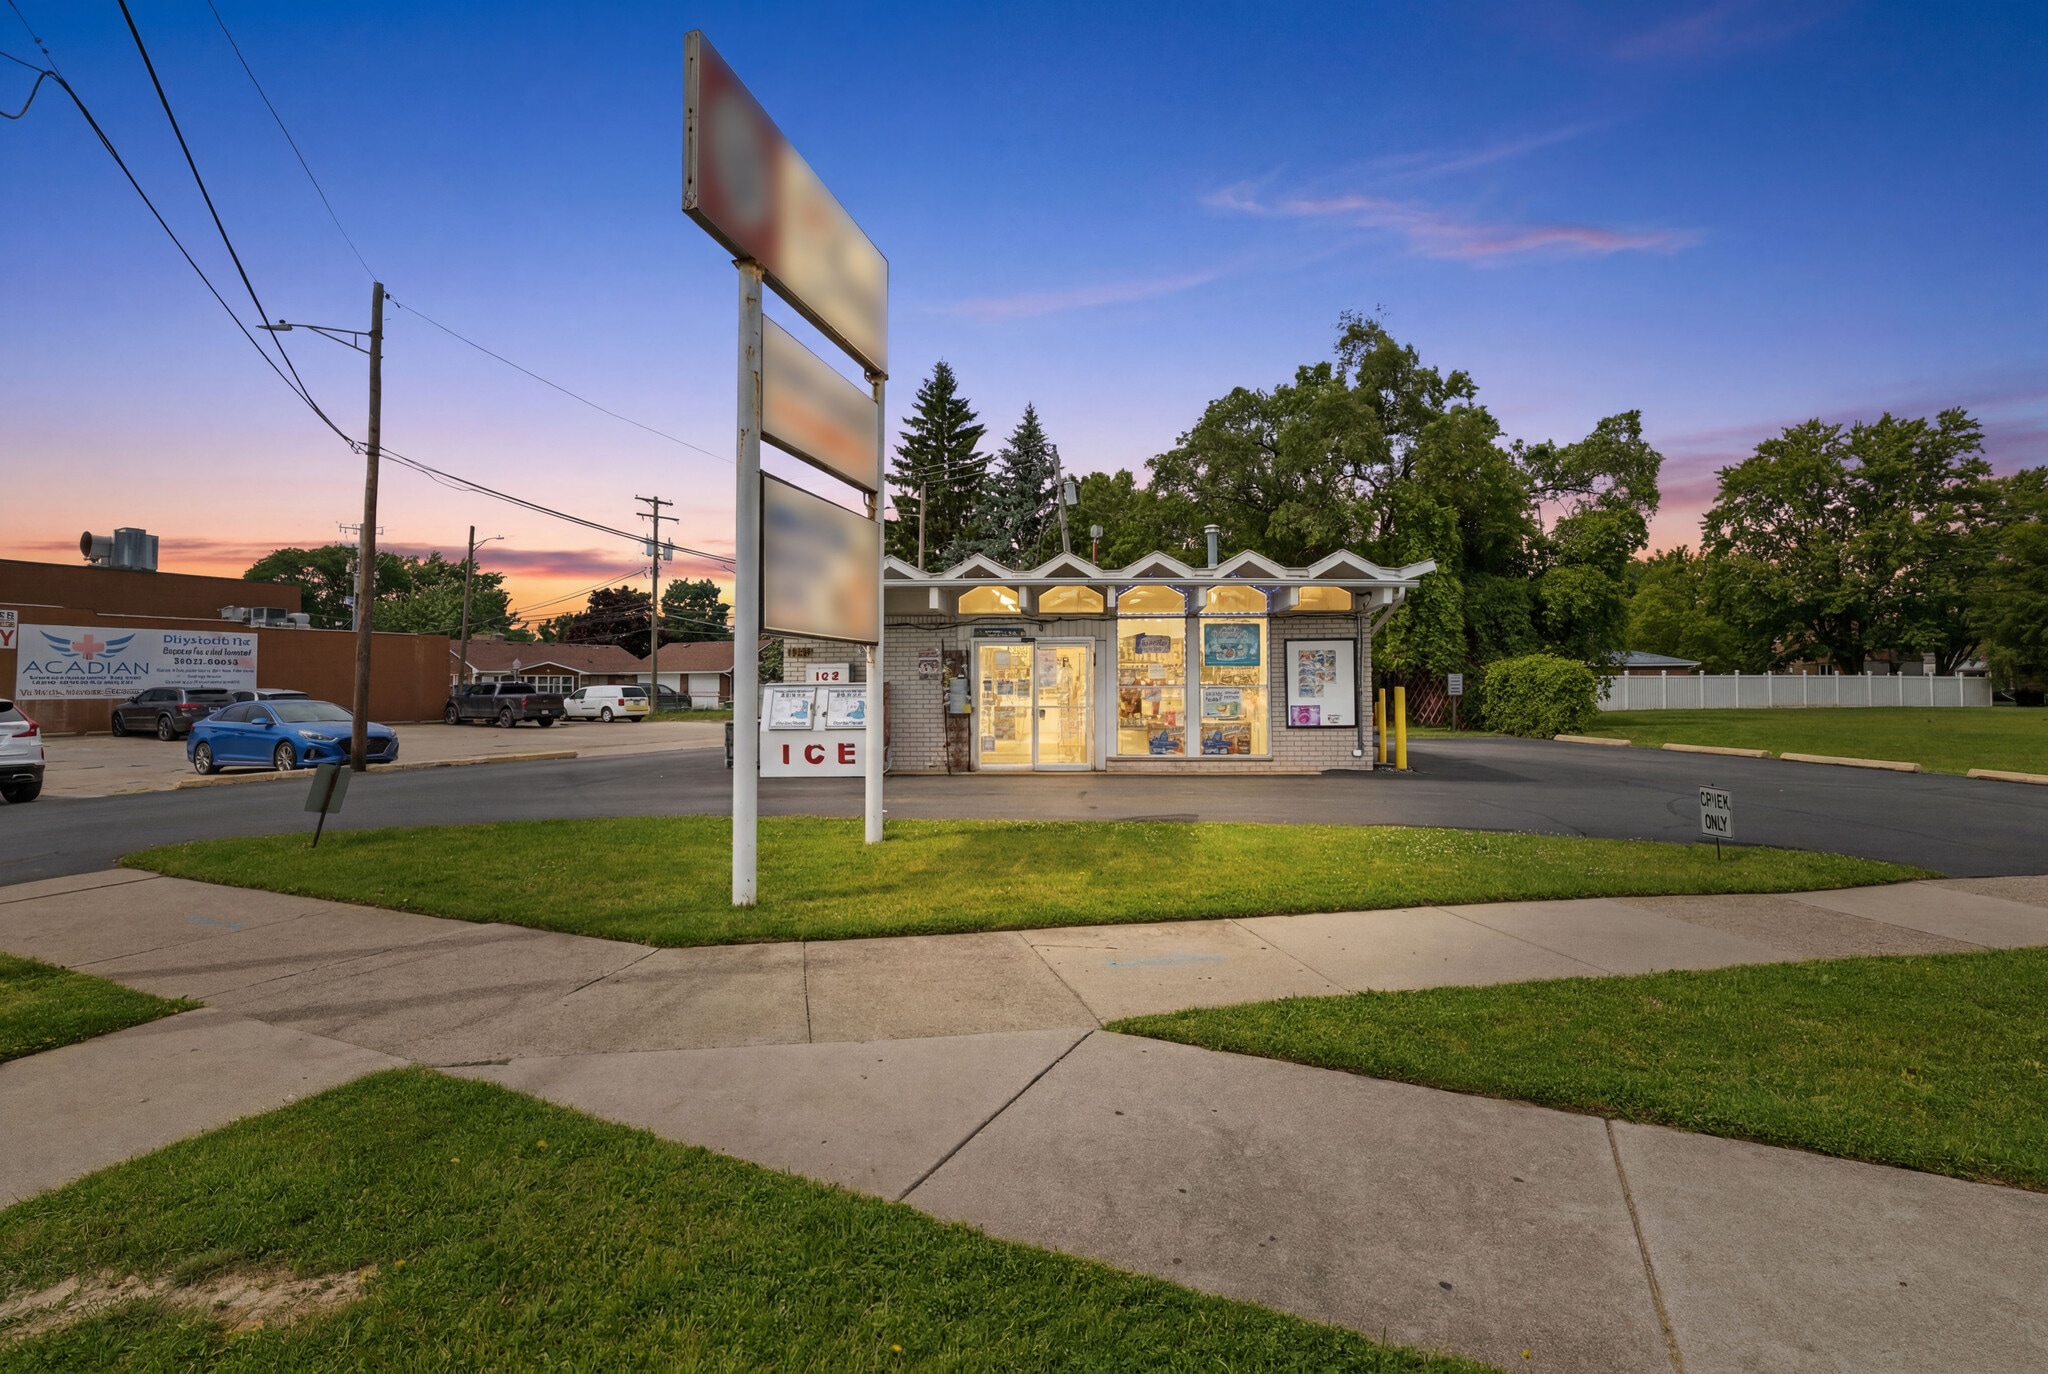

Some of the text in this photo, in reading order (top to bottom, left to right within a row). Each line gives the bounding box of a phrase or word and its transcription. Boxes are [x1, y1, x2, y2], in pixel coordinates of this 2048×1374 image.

[22, 660, 149, 675] ACADIAN
[782, 743, 856, 765] ICE
[1705, 813, 1727, 832] ONLY
